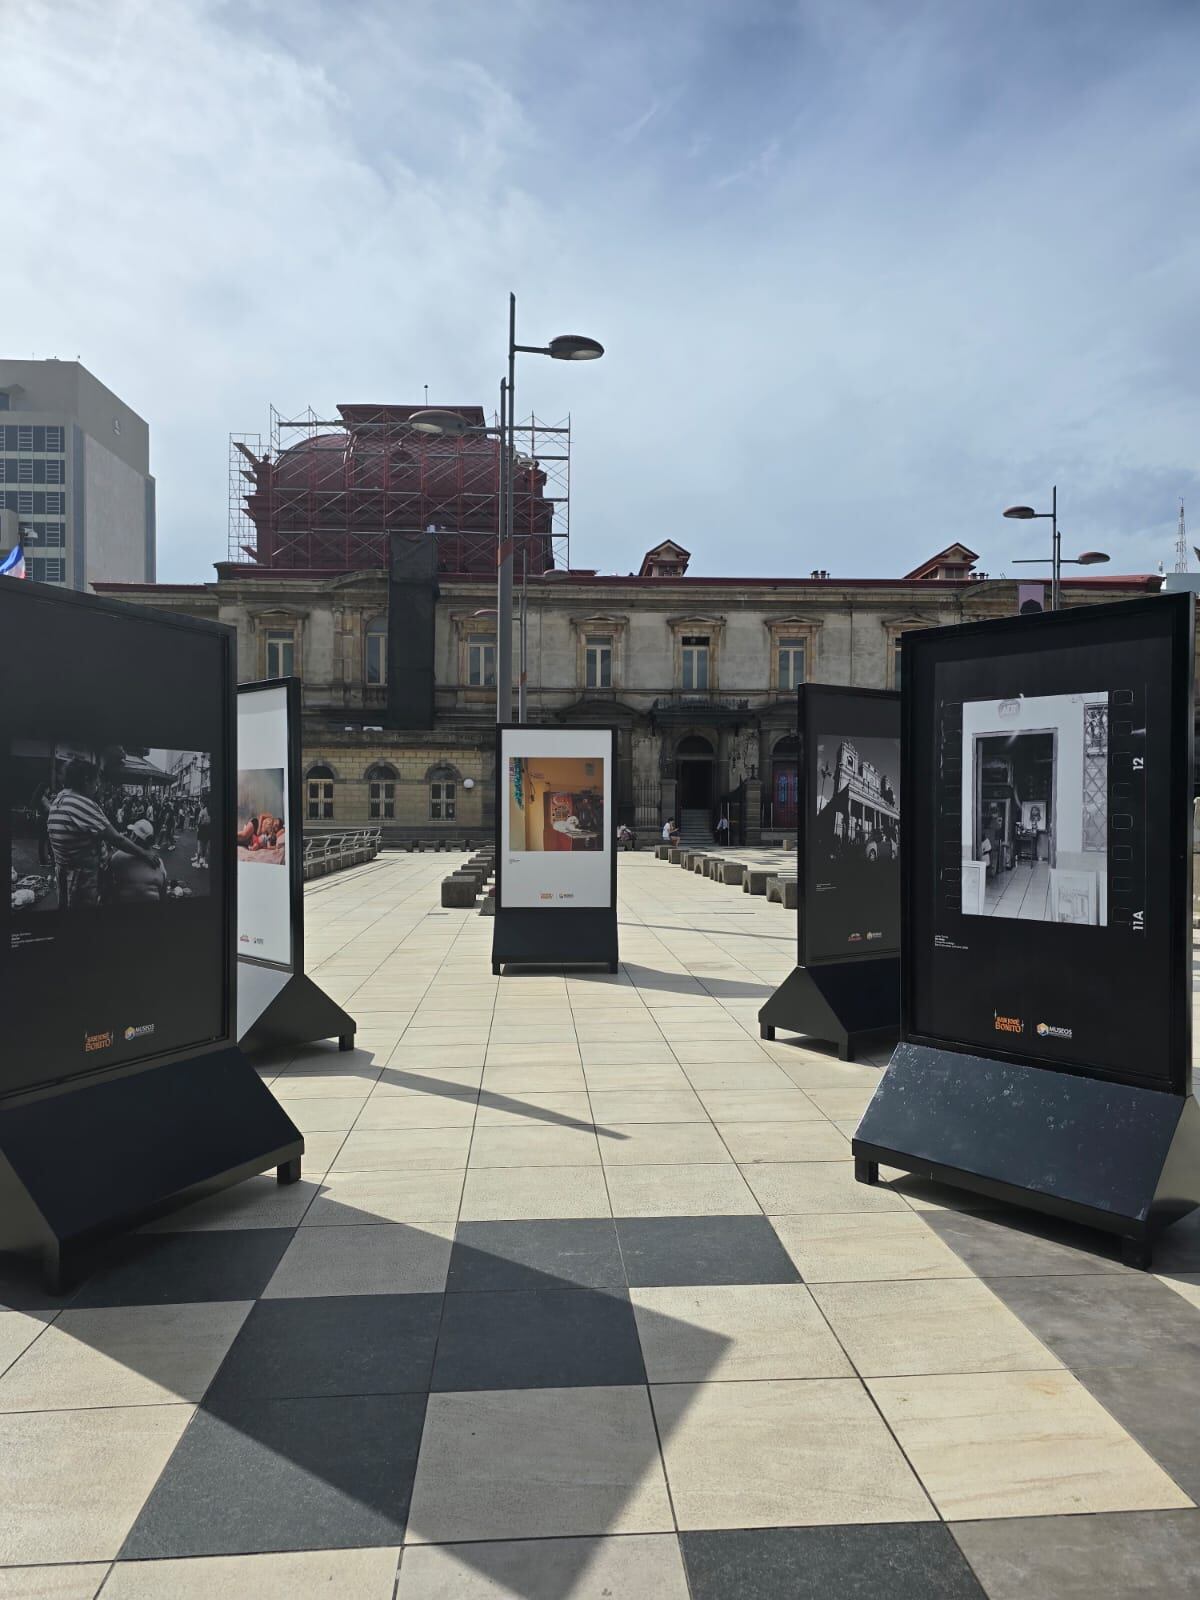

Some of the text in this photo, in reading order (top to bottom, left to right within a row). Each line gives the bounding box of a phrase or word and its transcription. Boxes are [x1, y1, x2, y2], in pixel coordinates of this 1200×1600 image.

[1132, 757, 1144, 771] 12
[1132, 910, 1144, 931] 11A
[995, 1021, 1021, 1033] BONITO
[1049, 1025, 1073, 1035] MUSEOS
